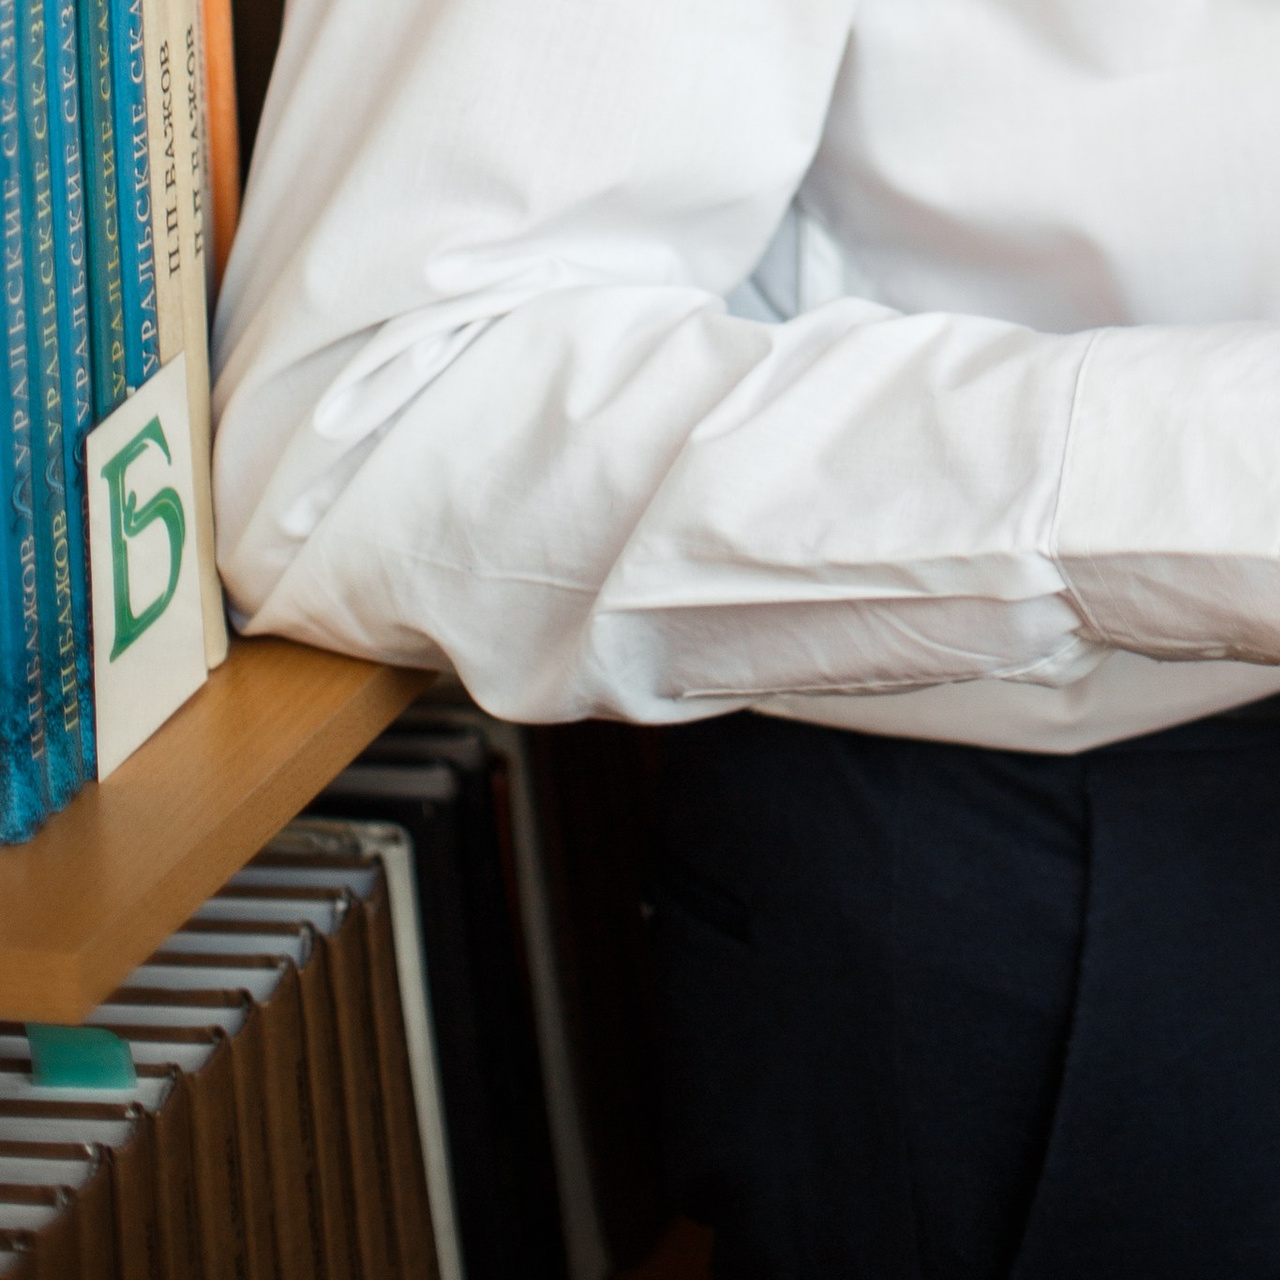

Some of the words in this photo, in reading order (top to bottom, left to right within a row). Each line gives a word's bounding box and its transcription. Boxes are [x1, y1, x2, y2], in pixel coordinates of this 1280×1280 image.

[4, 173, 32, 468] УРАЛЬСКИЕ
[35, 154, 63, 446] УРАЛЬСКИЕ
[65, 137, 91, 426] УРАЛЬСКИЕ
[101, 115, 127, 399] УРАЛЬСКИЕ
[132, 97, 159, 377] УРАЛЬСКИЕ
[100, 413, 187, 664] Б
